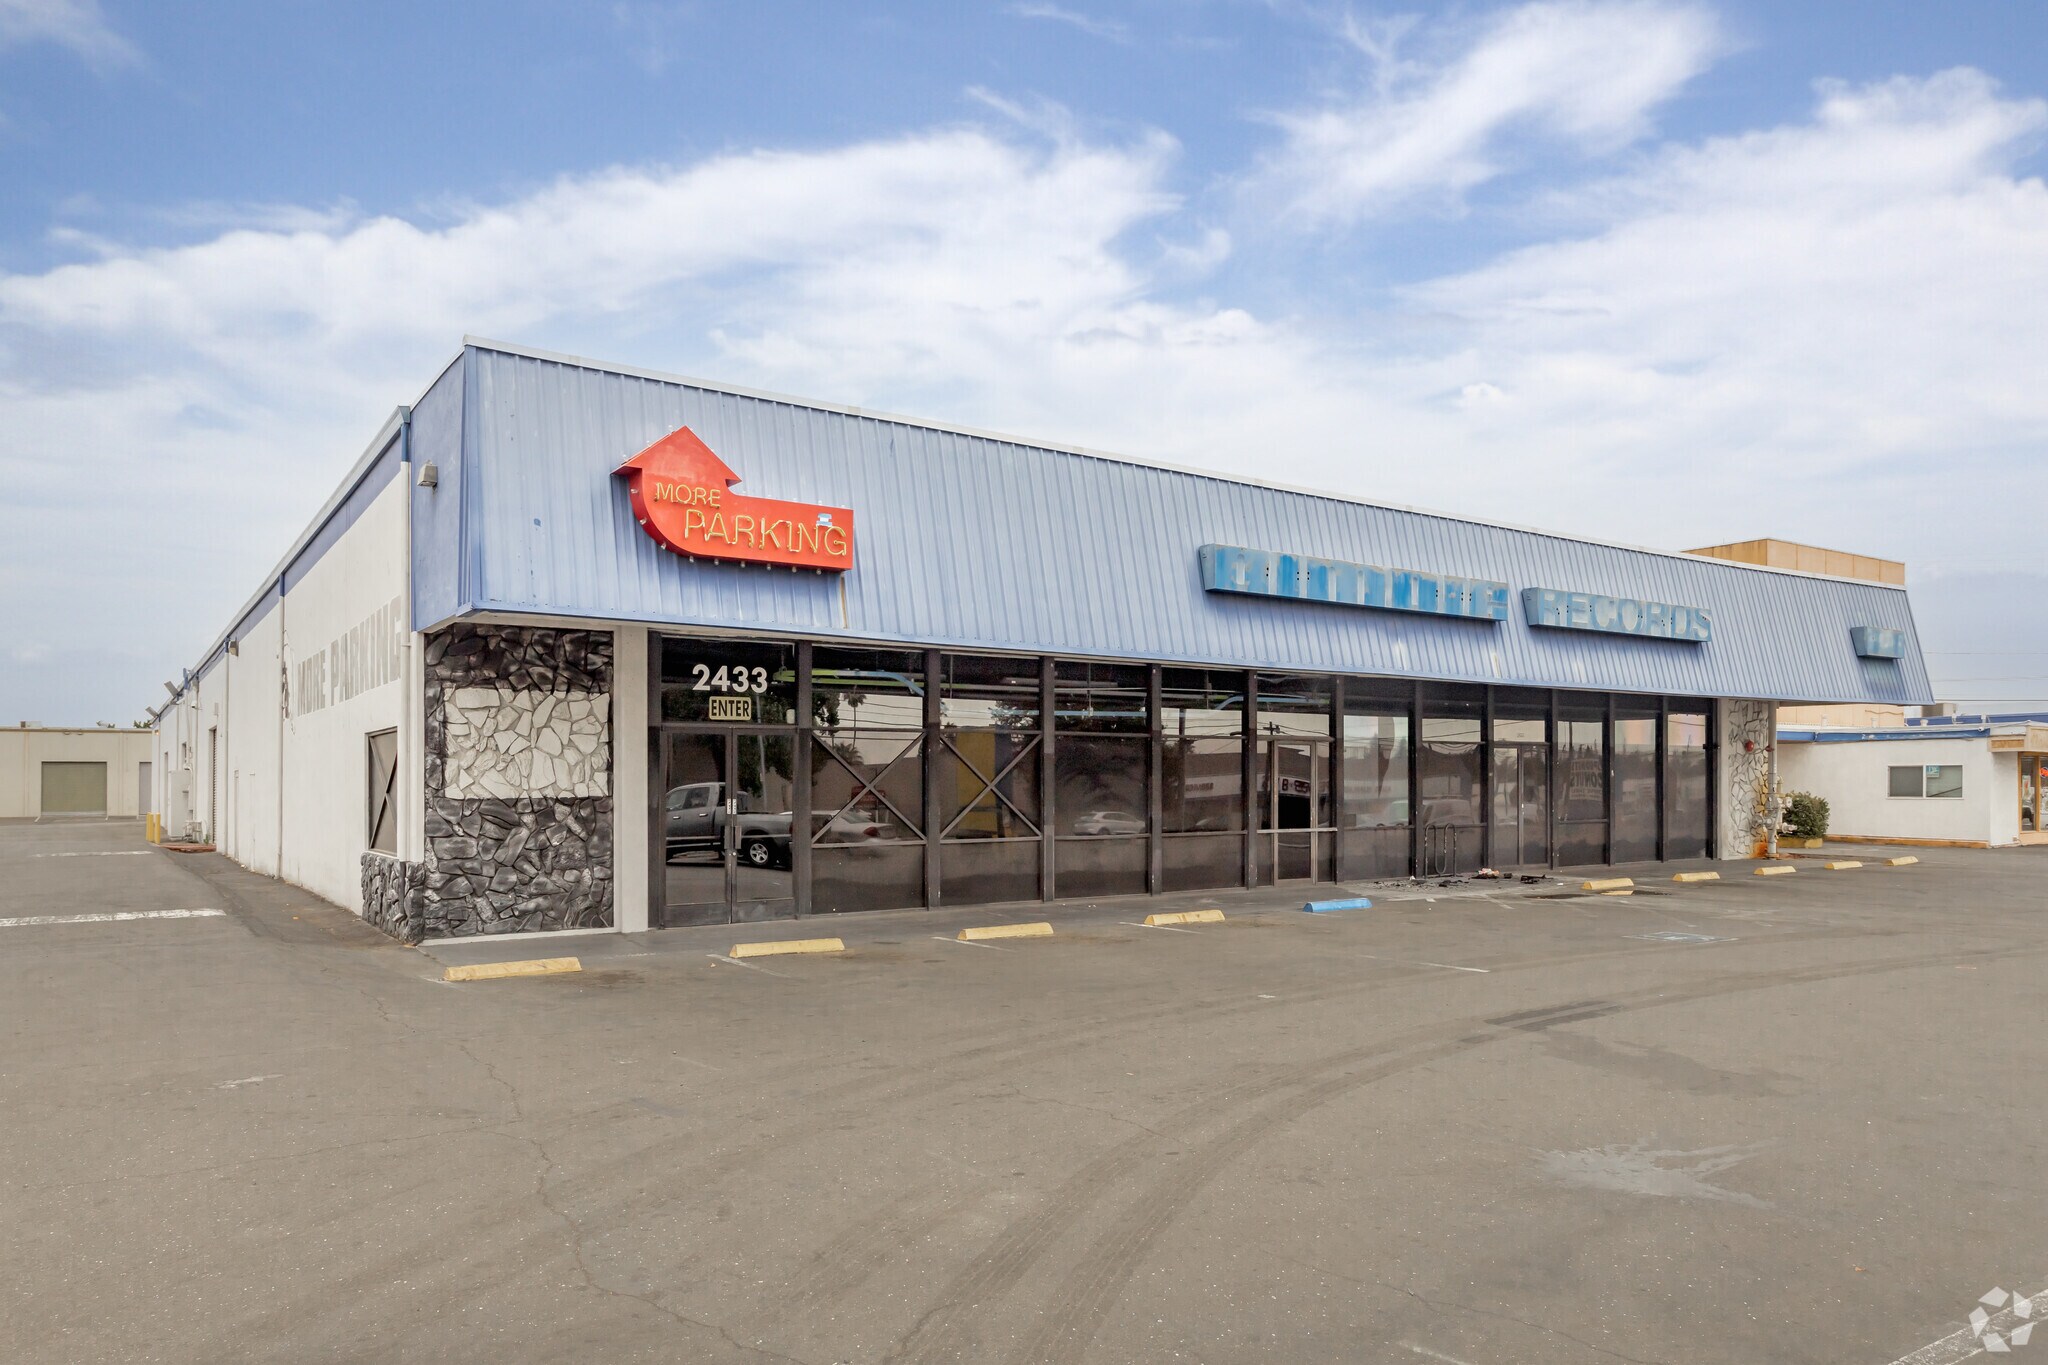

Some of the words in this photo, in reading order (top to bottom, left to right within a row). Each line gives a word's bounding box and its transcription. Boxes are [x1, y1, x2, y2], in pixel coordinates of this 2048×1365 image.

[653, 481, 721, 507] MORE
[684, 508, 847, 556] PARKING
[1538, 588, 1712, 642] RECORDS
[297, 649, 326, 718] MORE
[330, 595, 402, 708] PARKING
[692, 664, 768, 693] 2433
[711, 699, 750, 717] ENTER
